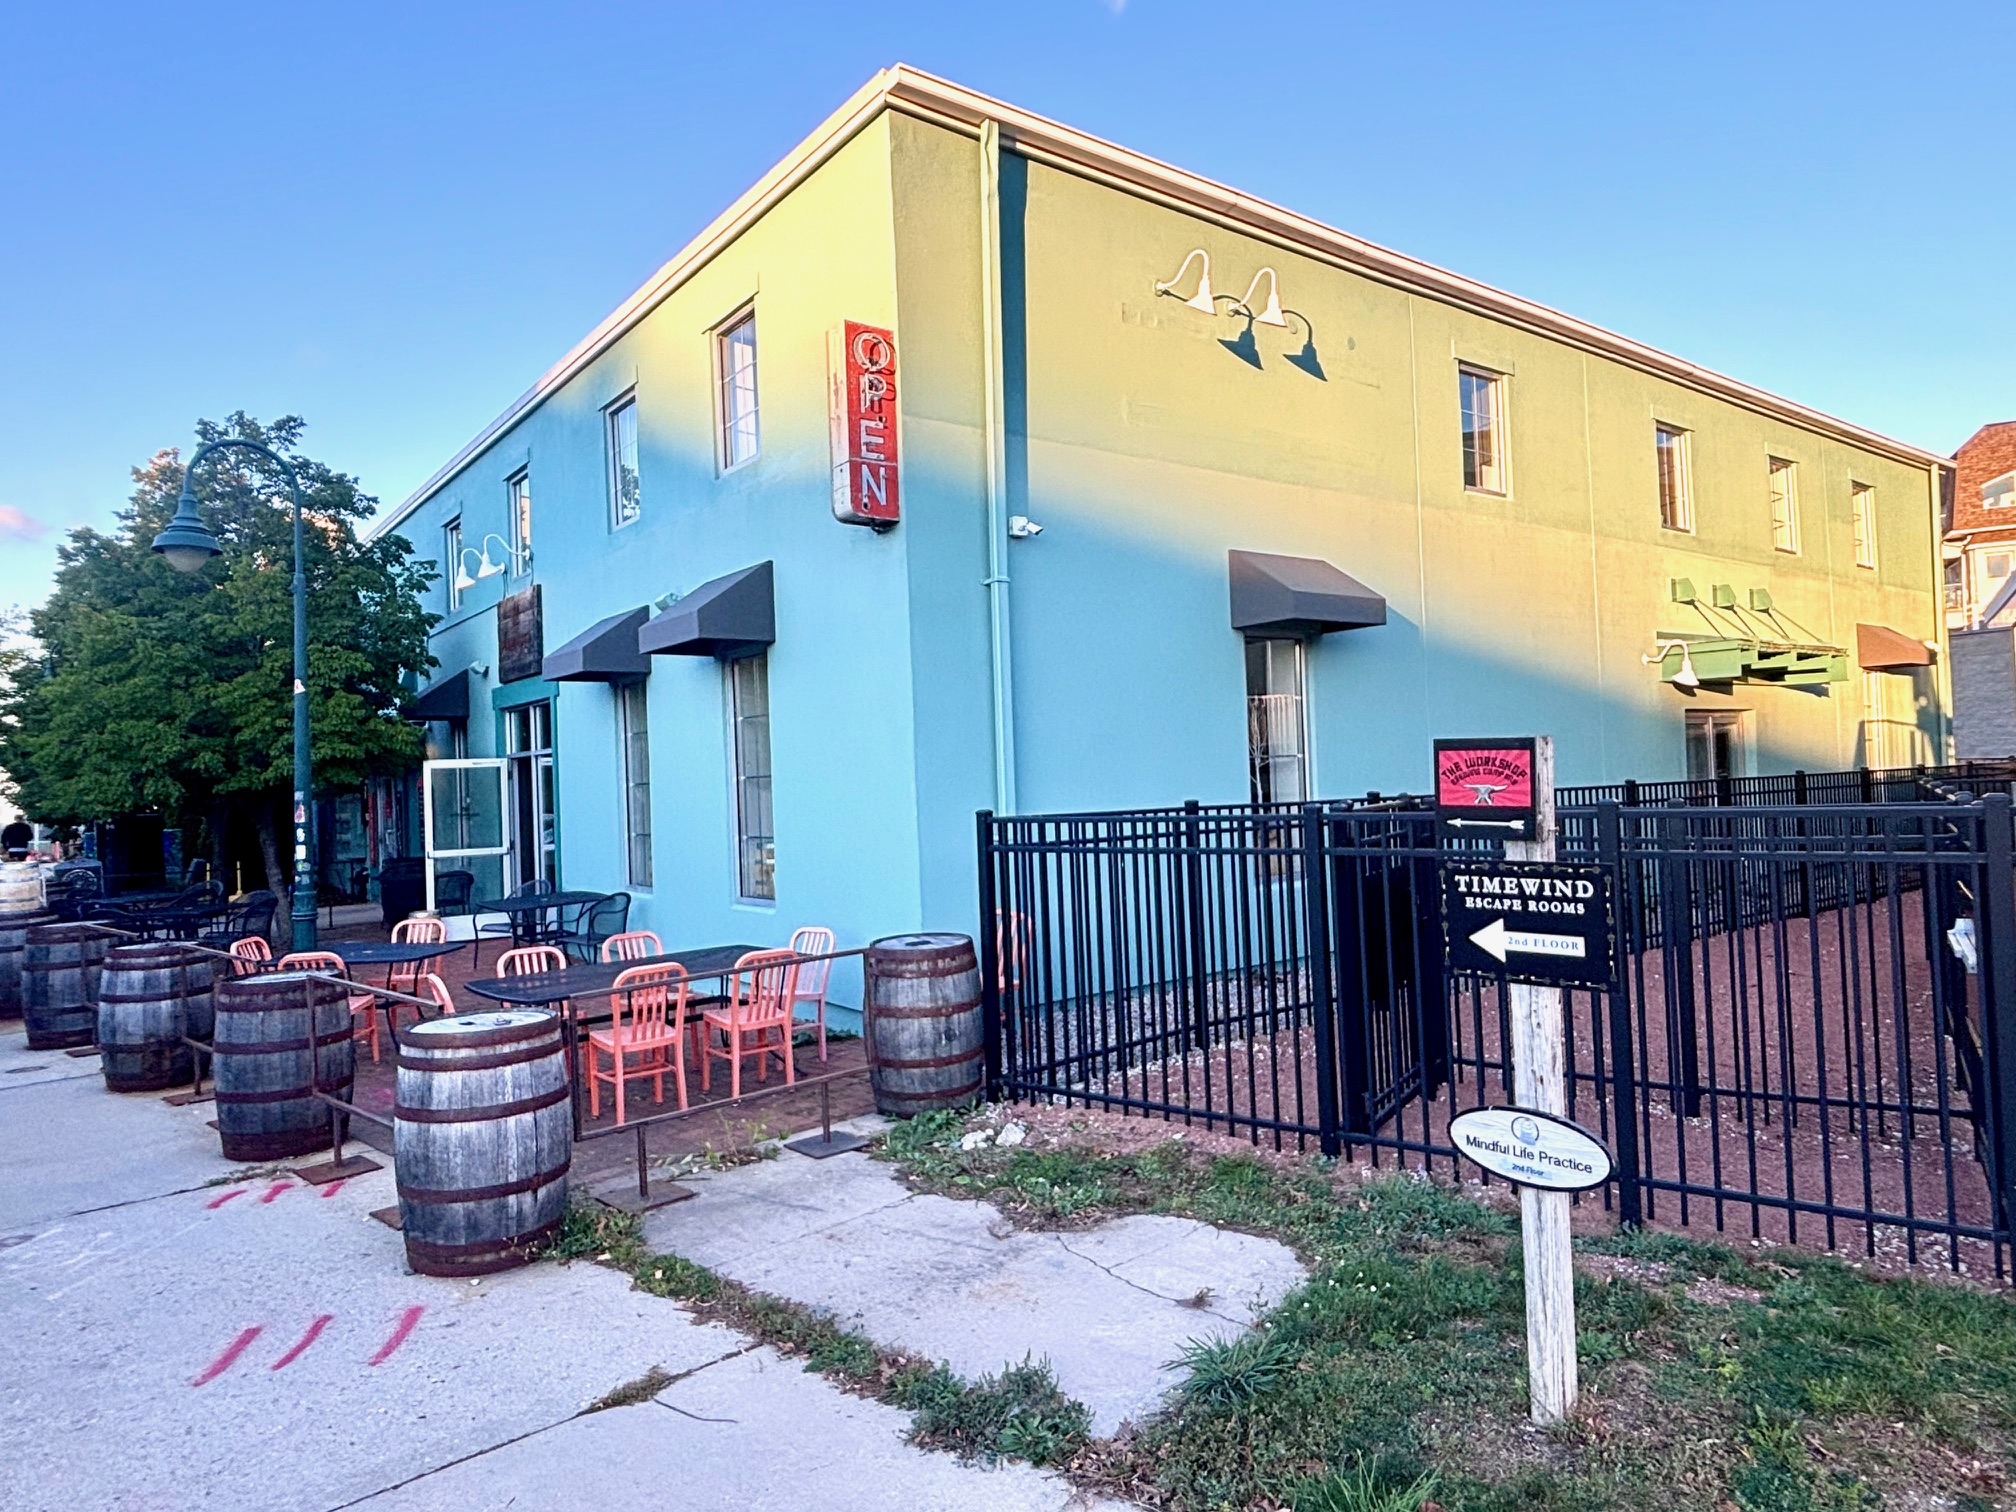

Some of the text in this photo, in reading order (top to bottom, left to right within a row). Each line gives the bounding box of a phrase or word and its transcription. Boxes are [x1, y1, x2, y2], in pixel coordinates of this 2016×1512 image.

[853, 331, 889, 511] OPEN
[1441, 756, 1528, 780] THE WORKSHOP
[1454, 875, 1595, 898] TIMEWIND
[1465, 896, 1585, 915] ESCAPE ROOMS
[1508, 936, 1579, 950] 2nd FLOOR
[1466, 1134, 1593, 1174] Mindful Life Practice
